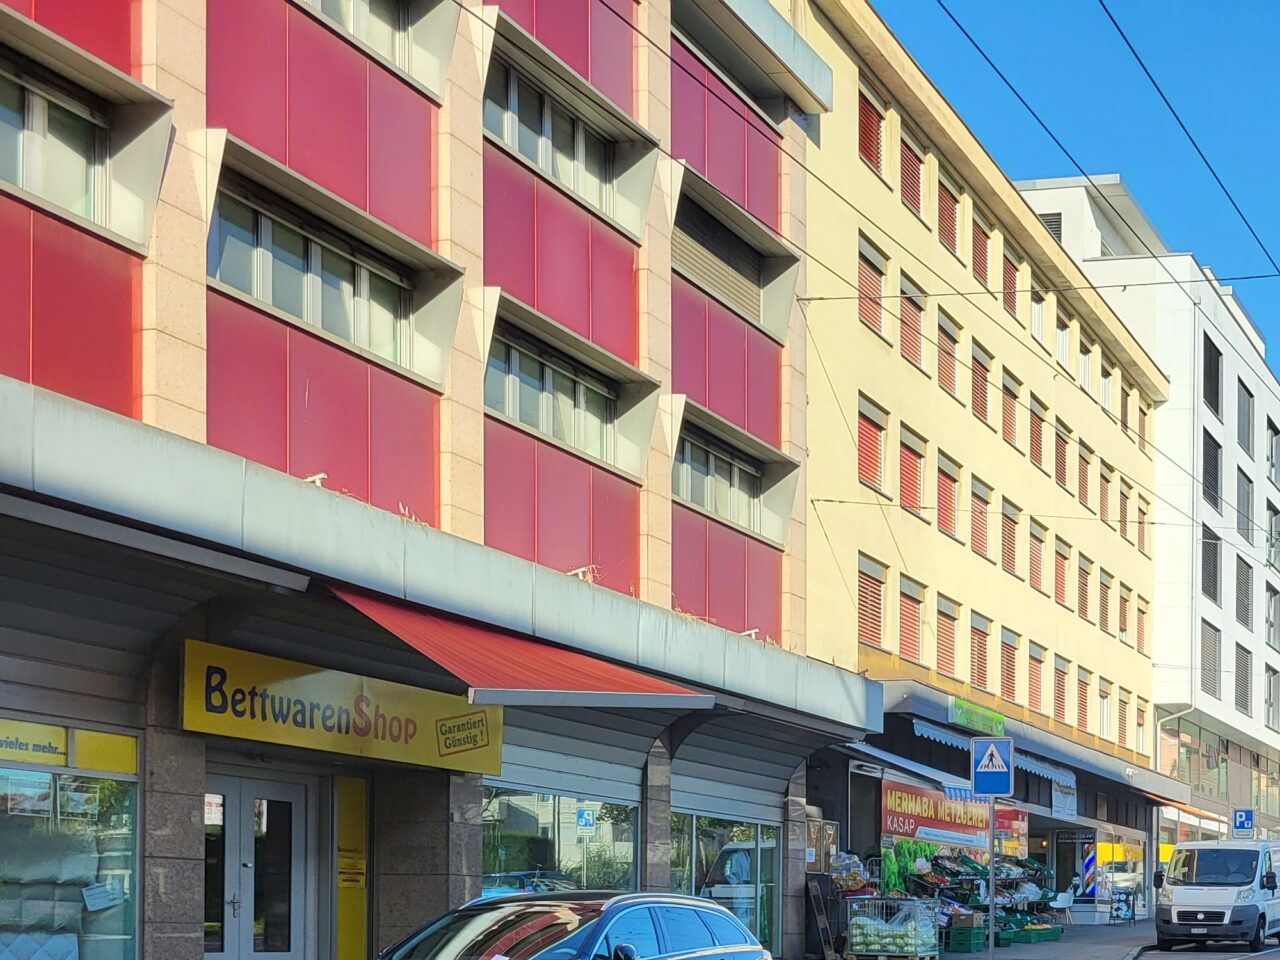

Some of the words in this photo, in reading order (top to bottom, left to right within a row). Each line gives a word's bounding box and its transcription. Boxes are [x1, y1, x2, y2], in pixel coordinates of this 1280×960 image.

[205, 665, 417, 744] BettwarenShop
[440, 717, 485, 736] Garantiert
[444, 732, 479, 749] Günstig
[887, 789, 935, 819] MERHABA
[938, 800, 986, 829] METZGEREI
[887, 815, 915, 834] KASAP
[1235, 811, 1246, 827] P
